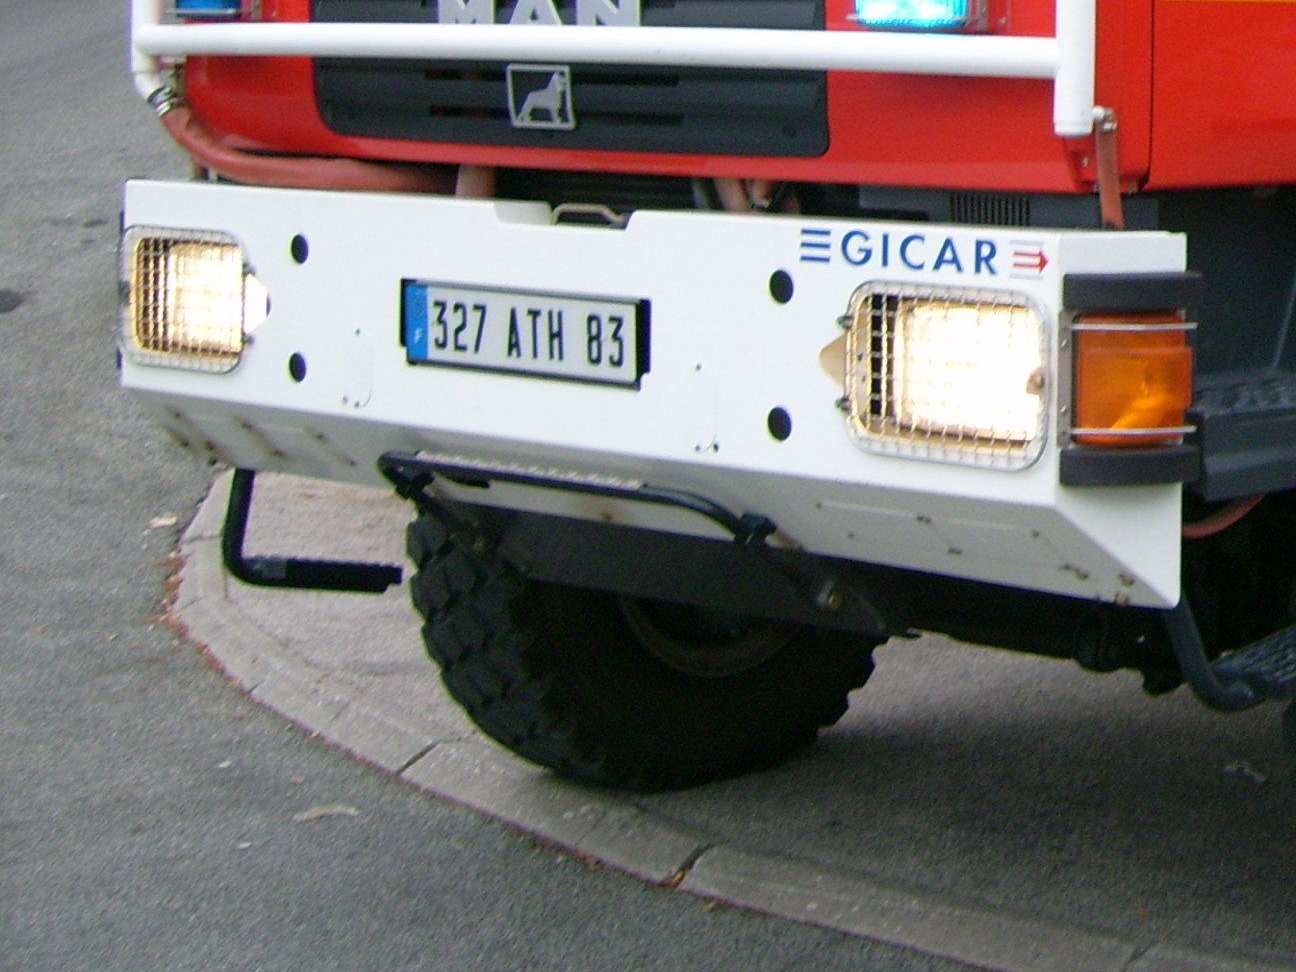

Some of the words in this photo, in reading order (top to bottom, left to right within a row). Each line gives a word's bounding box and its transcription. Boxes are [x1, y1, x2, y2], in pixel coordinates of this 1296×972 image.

[433, 300, 487, 353] 327
[507, 307, 563, 361] ATH
[587, 314, 625, 368] 83
